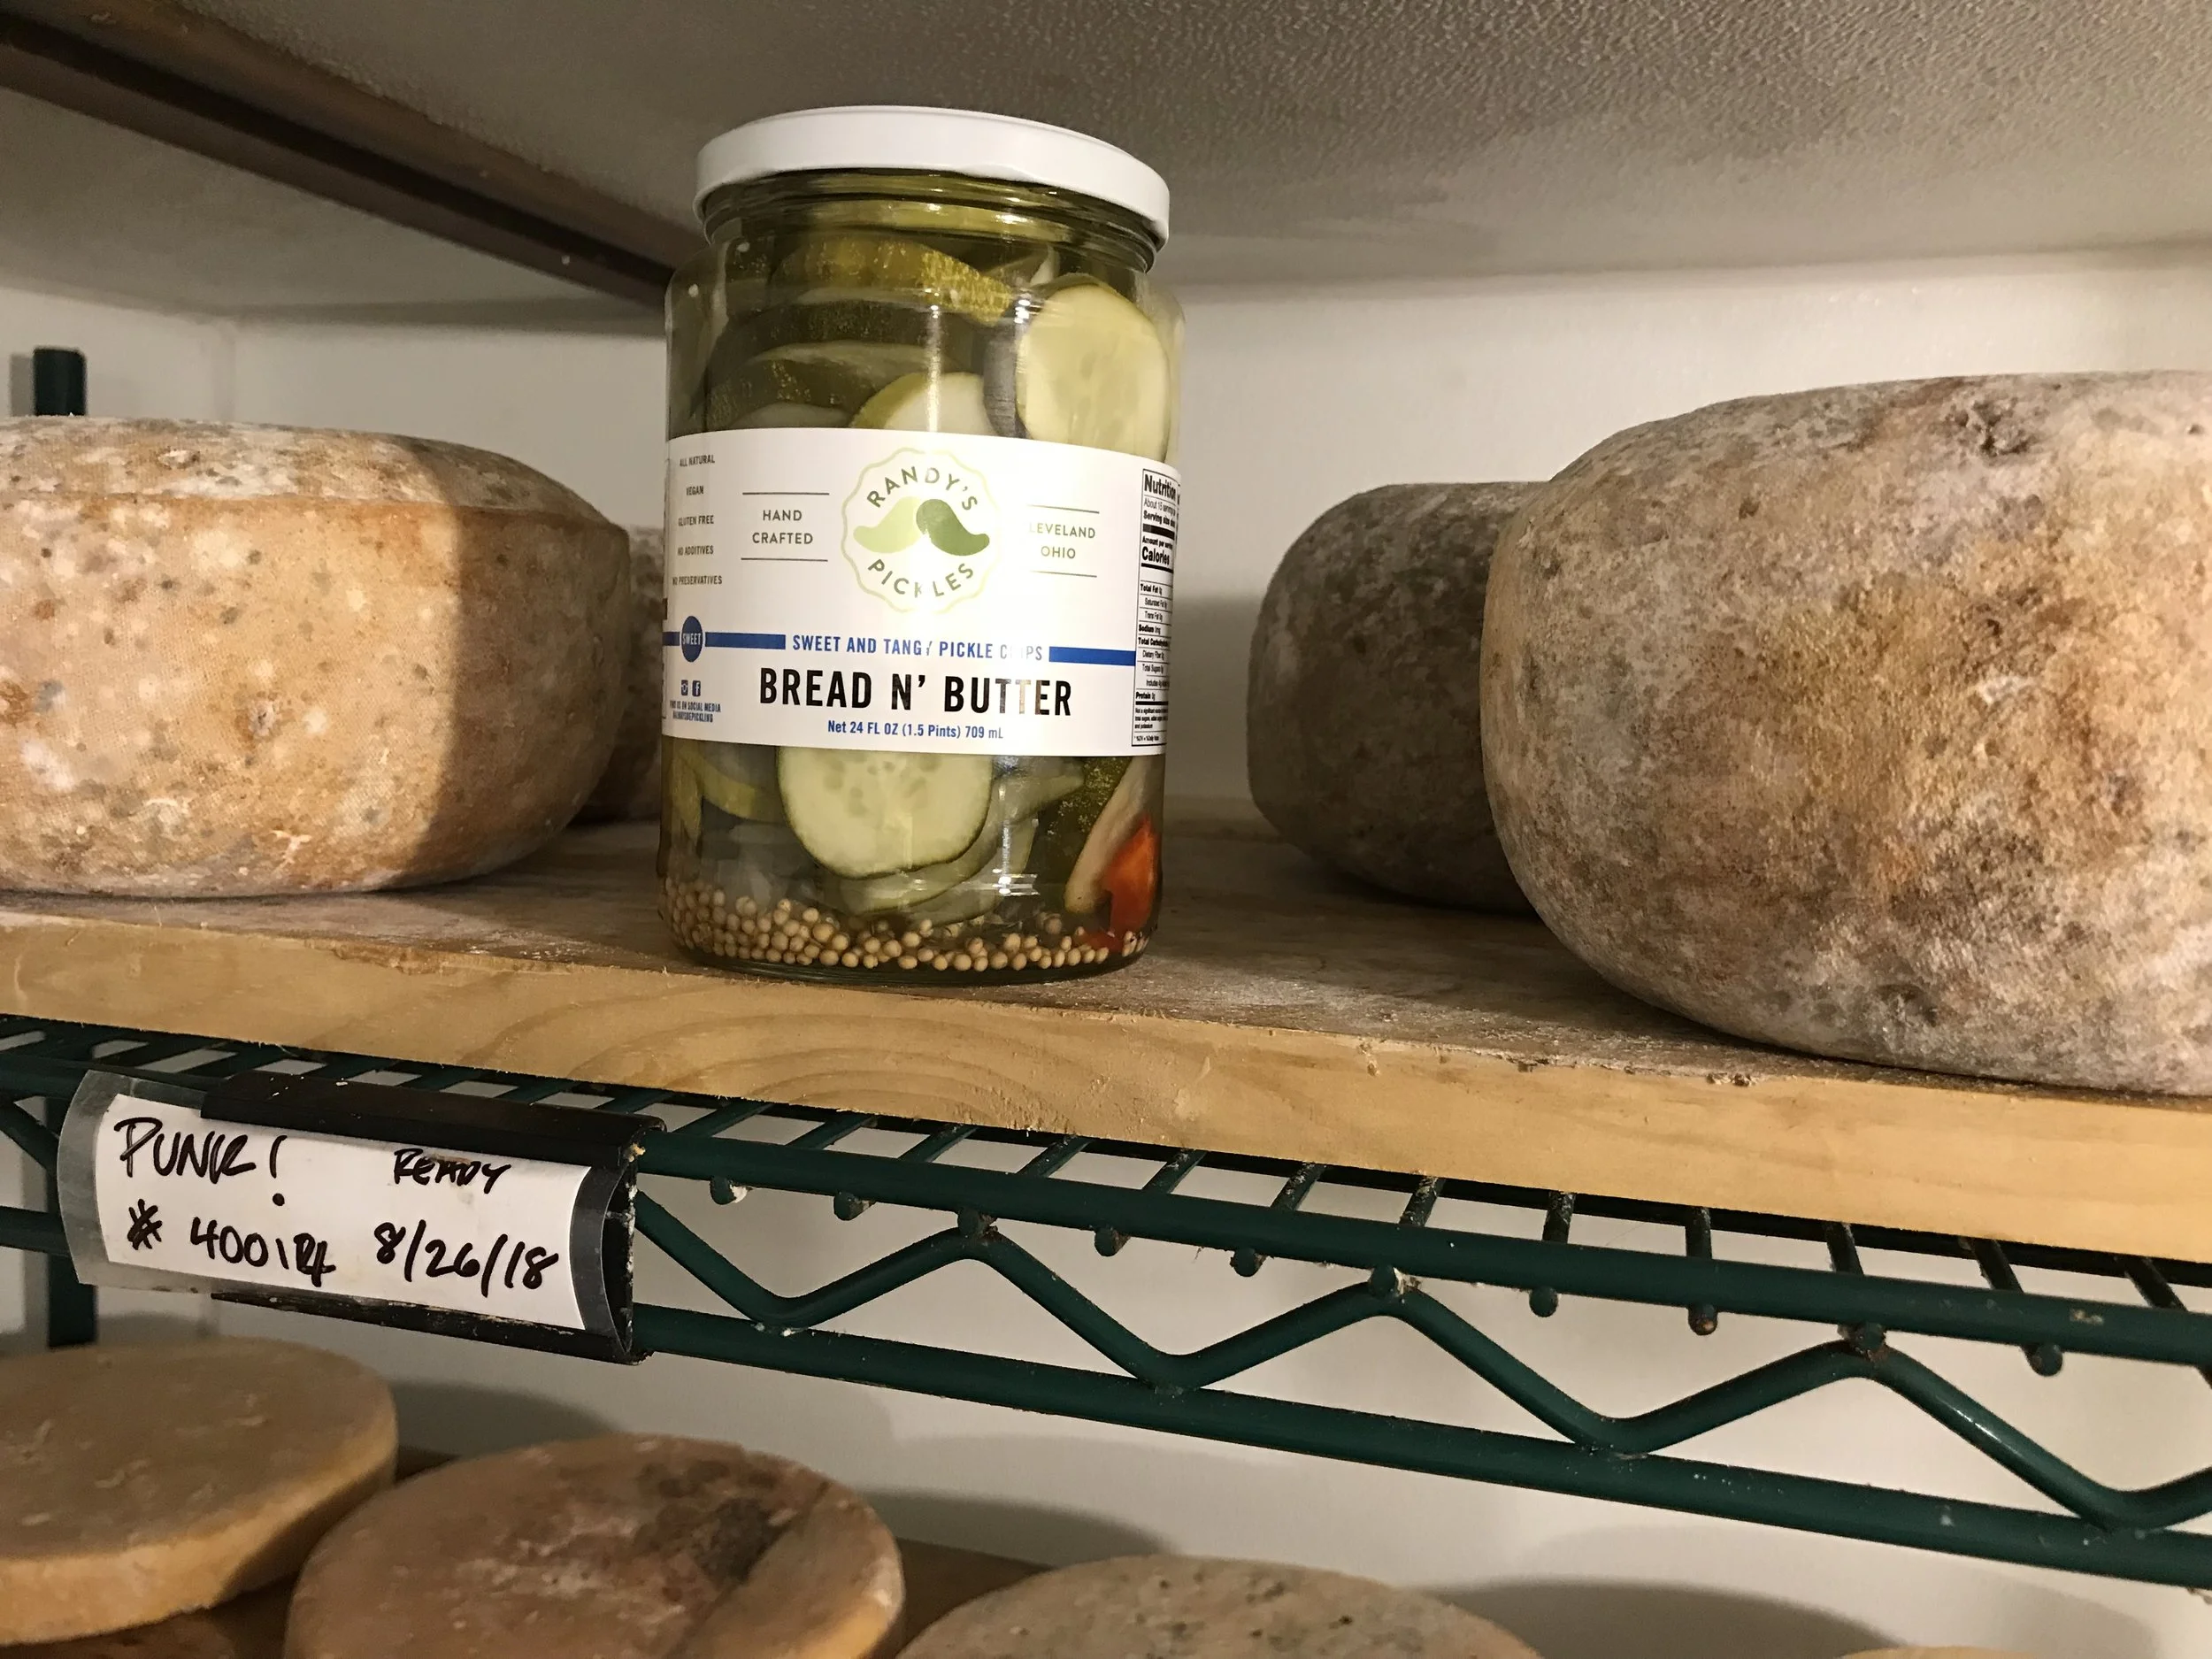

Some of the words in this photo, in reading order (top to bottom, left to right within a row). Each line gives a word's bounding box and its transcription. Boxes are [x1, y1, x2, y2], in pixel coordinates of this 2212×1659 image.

[689, 454, 715, 465] NATURAL
[686, 485, 703, 495] VEGAN
[866, 466, 978, 511] RANDY'S
[1144, 473, 1176, 501] Nutrition
[678, 516, 696, 526] GLUTEN
[698, 515, 714, 525] FREE
[763, 510, 803, 521] HAND
[752, 533, 813, 544] CRAFTED
[1028, 522, 1095, 539] LEVELAND
[685, 545, 714, 555] ADDITIVES
[1041, 546, 1076, 559] OHIO
[1142, 546, 1170, 566] Calories
[679, 575, 723, 585] PRESERVATIVES
[867, 559, 973, 597] PICKLES
[682, 633, 702, 645] SWEET
[793, 634, 841, 652] SWEET
[846, 637, 877, 654] AND
[939, 641, 993, 658] PICKLE
[760, 667, 872, 709] BREAD
[891, 673, 926, 710] N'
[944, 676, 1071, 716] BUTTER
[827, 720, 846, 733] Net
[849, 722, 864, 733] 24
[867, 722, 880, 734] FL
[885, 723, 898, 735] OZ
[902, 724, 924, 737] (1.5
[927, 725, 961, 739] Pints)
[965, 726, 985, 738] 709
[988, 727, 1003, 739] mL
[393, 1147, 511, 1194] READY
[373, 1218, 559, 1299] 8/26/18
